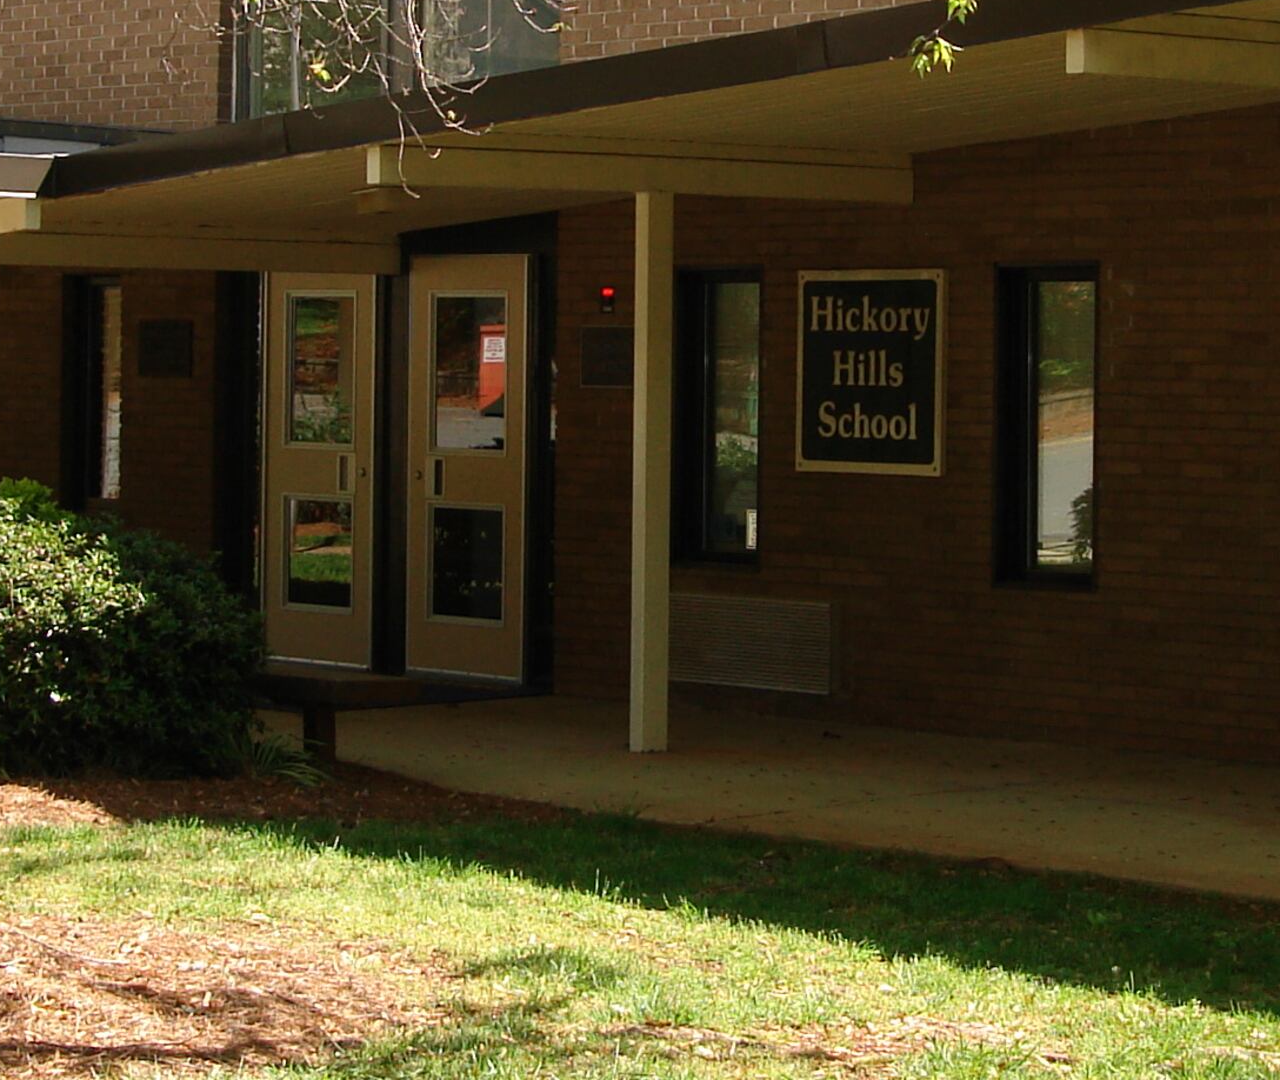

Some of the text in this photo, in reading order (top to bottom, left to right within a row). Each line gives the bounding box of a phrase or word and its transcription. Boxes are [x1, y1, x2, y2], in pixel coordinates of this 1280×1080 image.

[810, 295, 930, 340] Hickory
[833, 350, 903, 387] Hills
[818, 401, 917, 440] School
